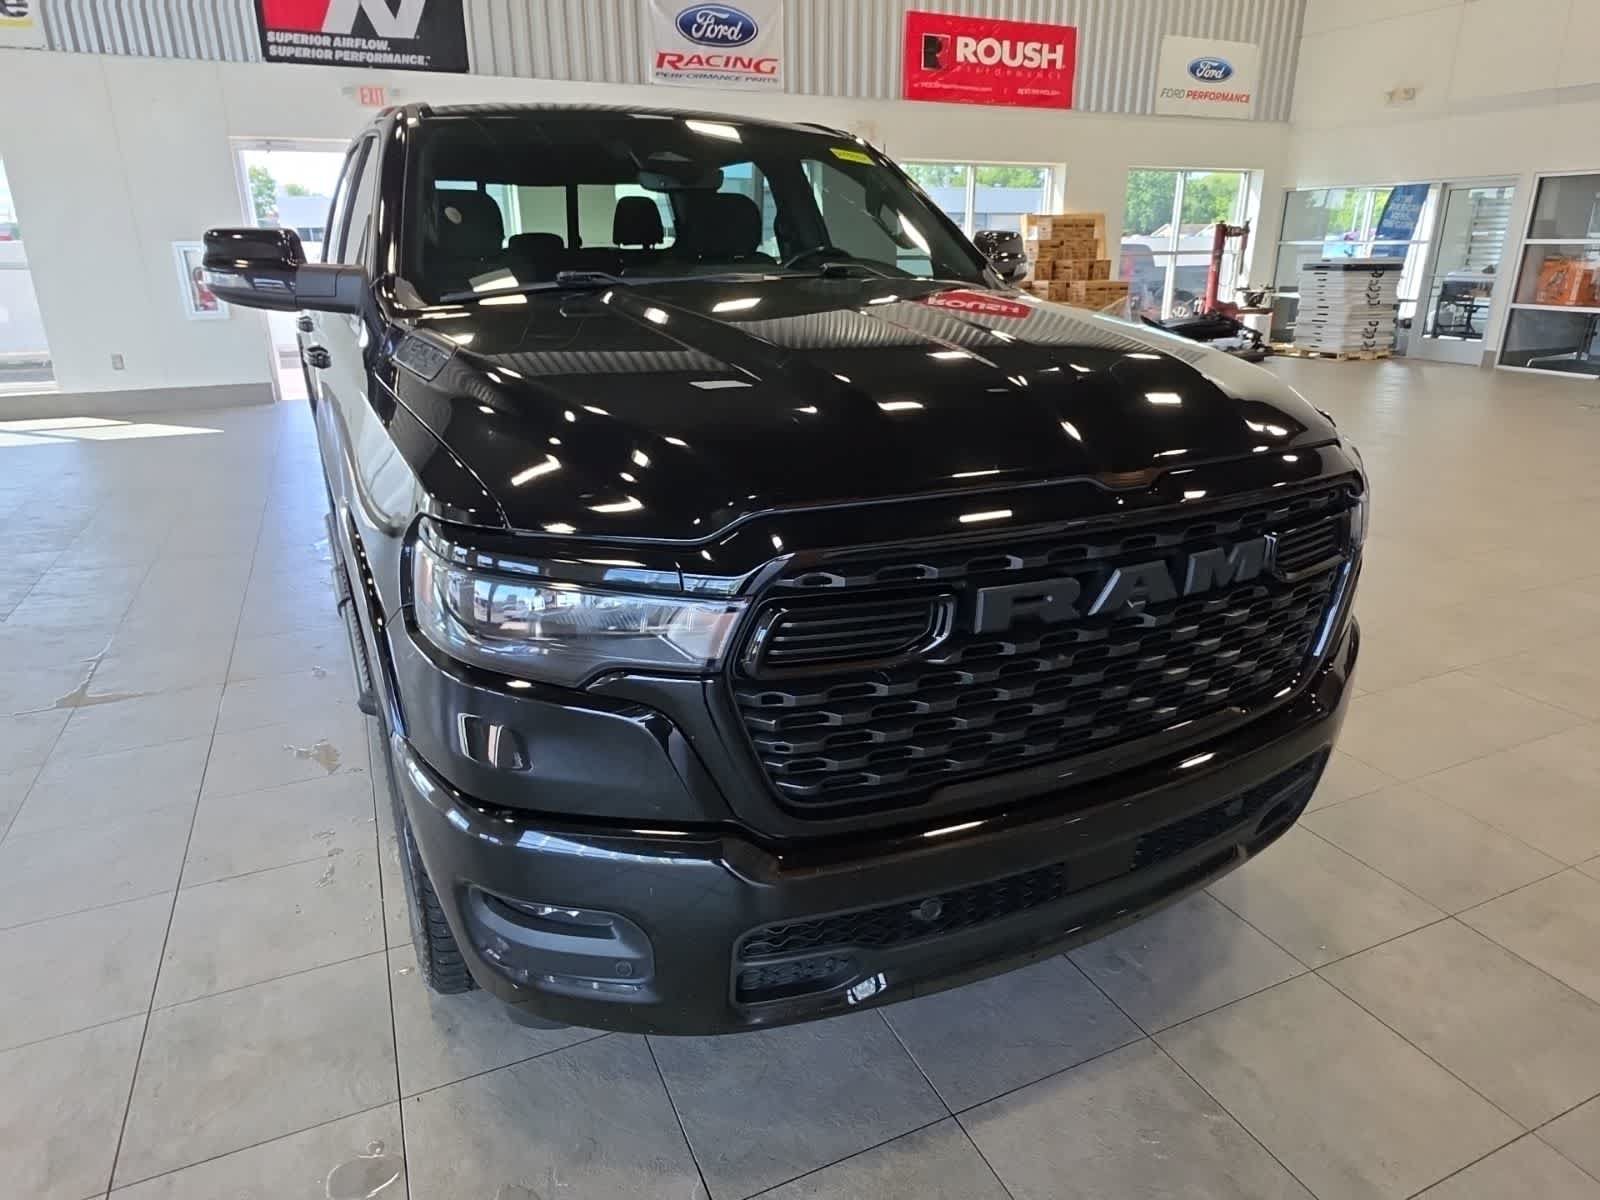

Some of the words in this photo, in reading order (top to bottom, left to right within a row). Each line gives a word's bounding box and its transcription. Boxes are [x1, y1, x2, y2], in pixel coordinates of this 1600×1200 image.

[691, 9, 742, 41] Ford
[267, 31, 332, 47] SUPERIOR
[333, 36, 391, 51] AIRFLOW.
[269, 44, 334, 60] SUPERIOR
[956, 36, 1065, 70] ROUSH
[656, 52, 779, 74] RACING
[655, 72, 742, 82] PERFORMANCE
[359, 86, 385, 106] EXIT
[1160, 87, 1186, 99] FORD
[1186, 89, 1250, 104] PERFORMANCE
[974, 538, 1266, 635] RAM
